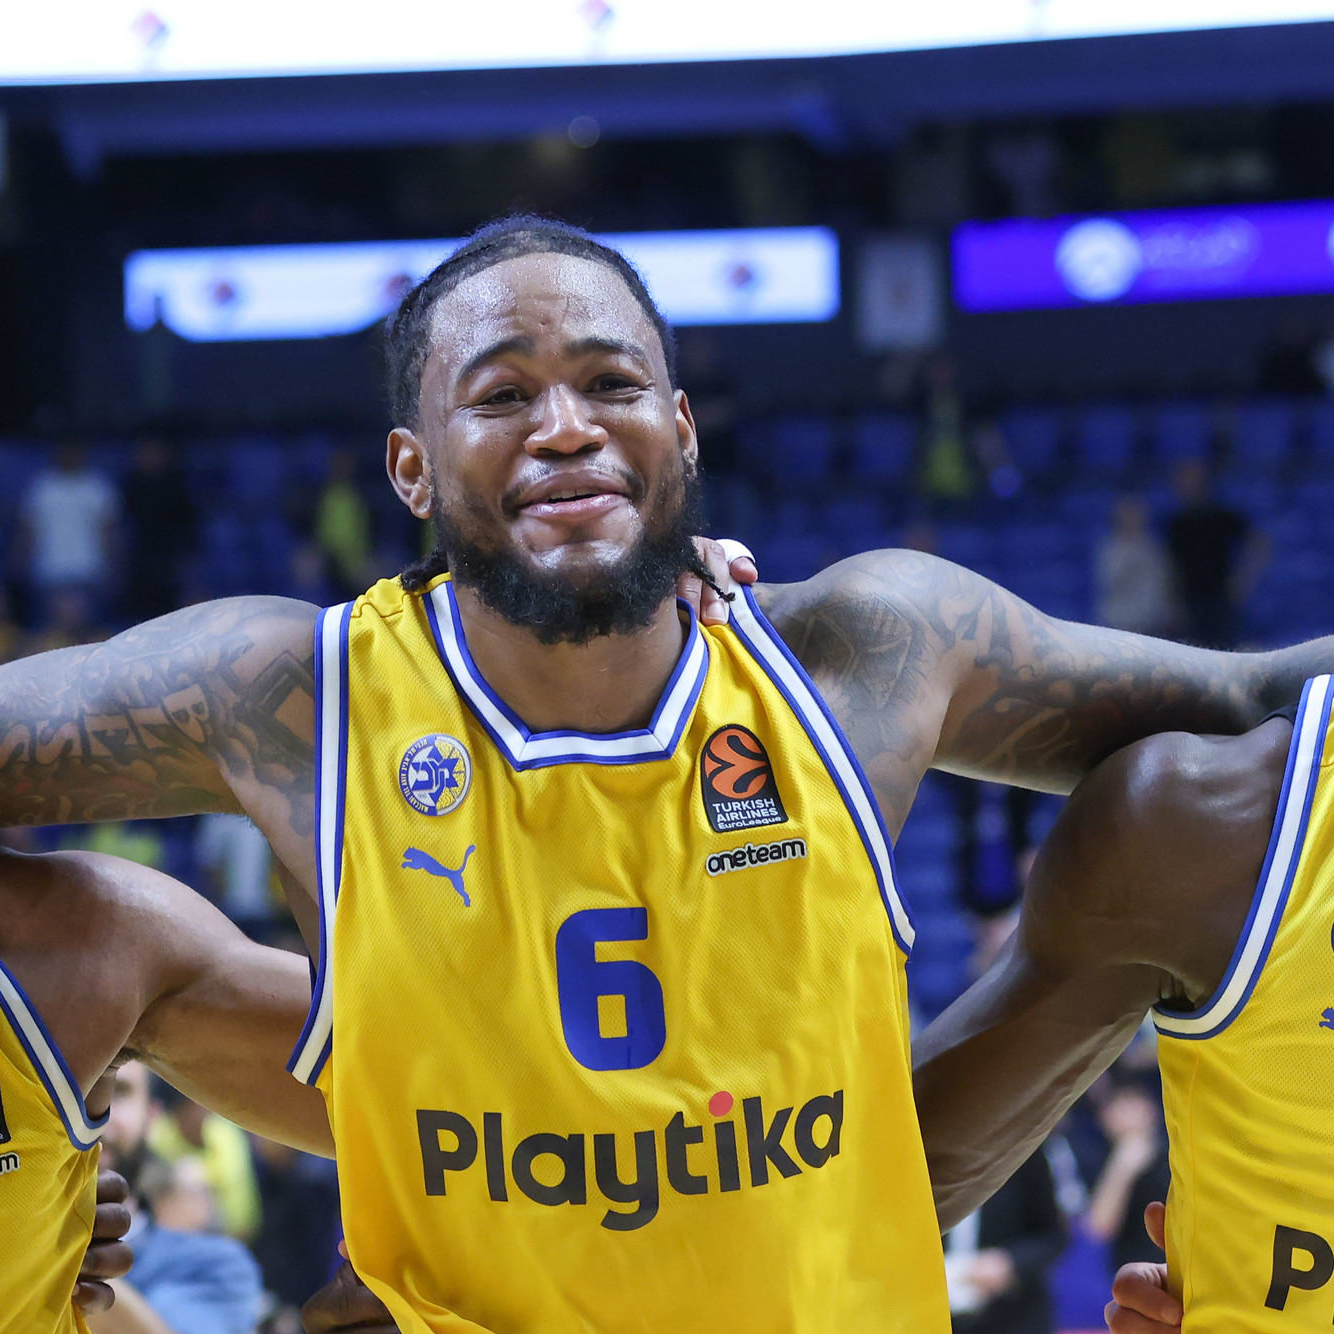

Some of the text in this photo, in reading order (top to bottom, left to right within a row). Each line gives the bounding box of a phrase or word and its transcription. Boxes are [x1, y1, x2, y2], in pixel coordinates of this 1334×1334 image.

[712, 798, 775, 813] TURKISH
[717, 808, 778, 822] AIRLINES
[718, 816, 781, 829] EuroLeague
[707, 840, 805, 873] oneteam
[555, 907, 667, 1072] 6
[415, 1090, 844, 1232] Playtika
